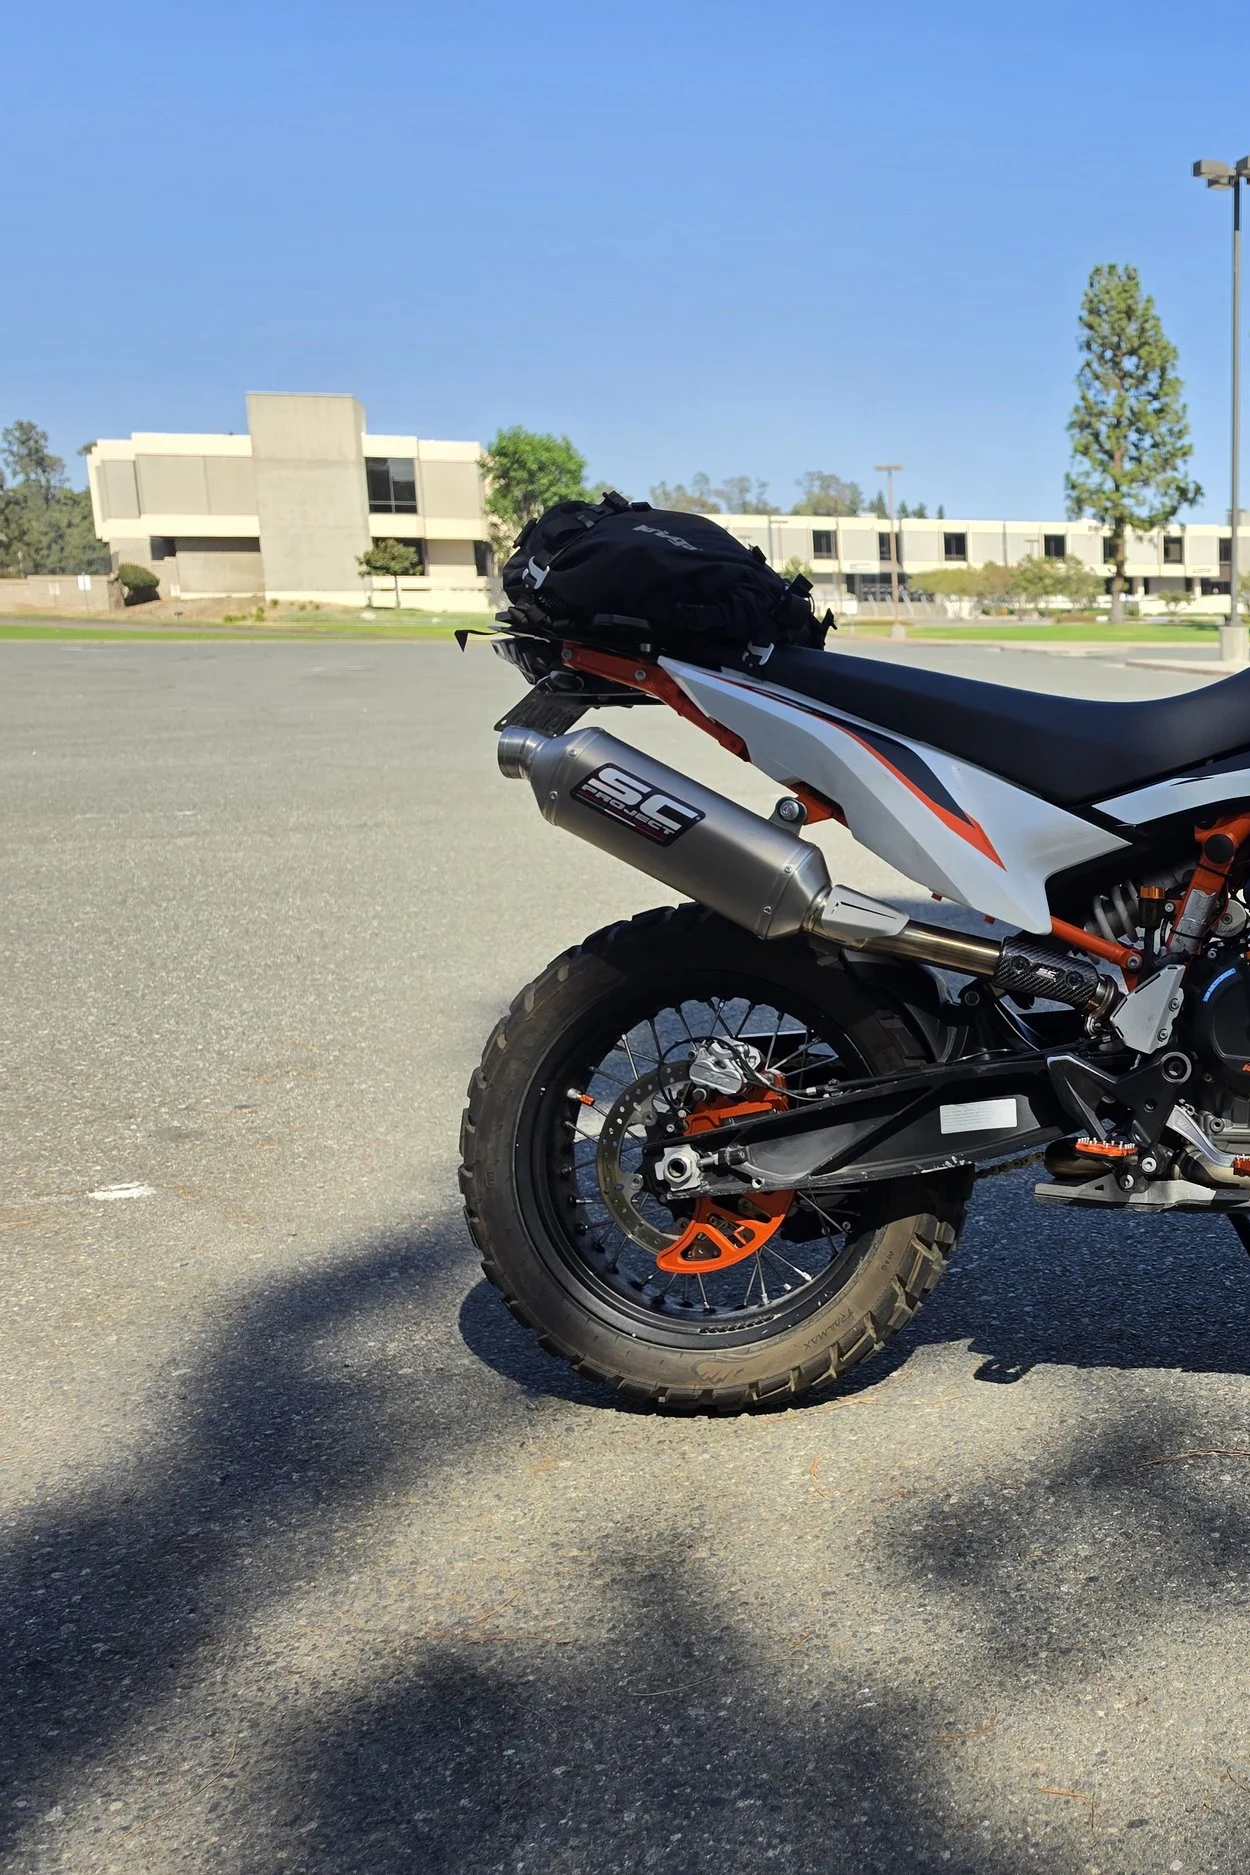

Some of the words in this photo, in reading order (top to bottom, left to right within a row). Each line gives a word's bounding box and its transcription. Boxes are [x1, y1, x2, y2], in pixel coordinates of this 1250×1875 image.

[581, 783, 675, 835] PROJECT
[587, 767, 699, 831] SC
[803, 1308, 854, 1351] TRAILMAX
